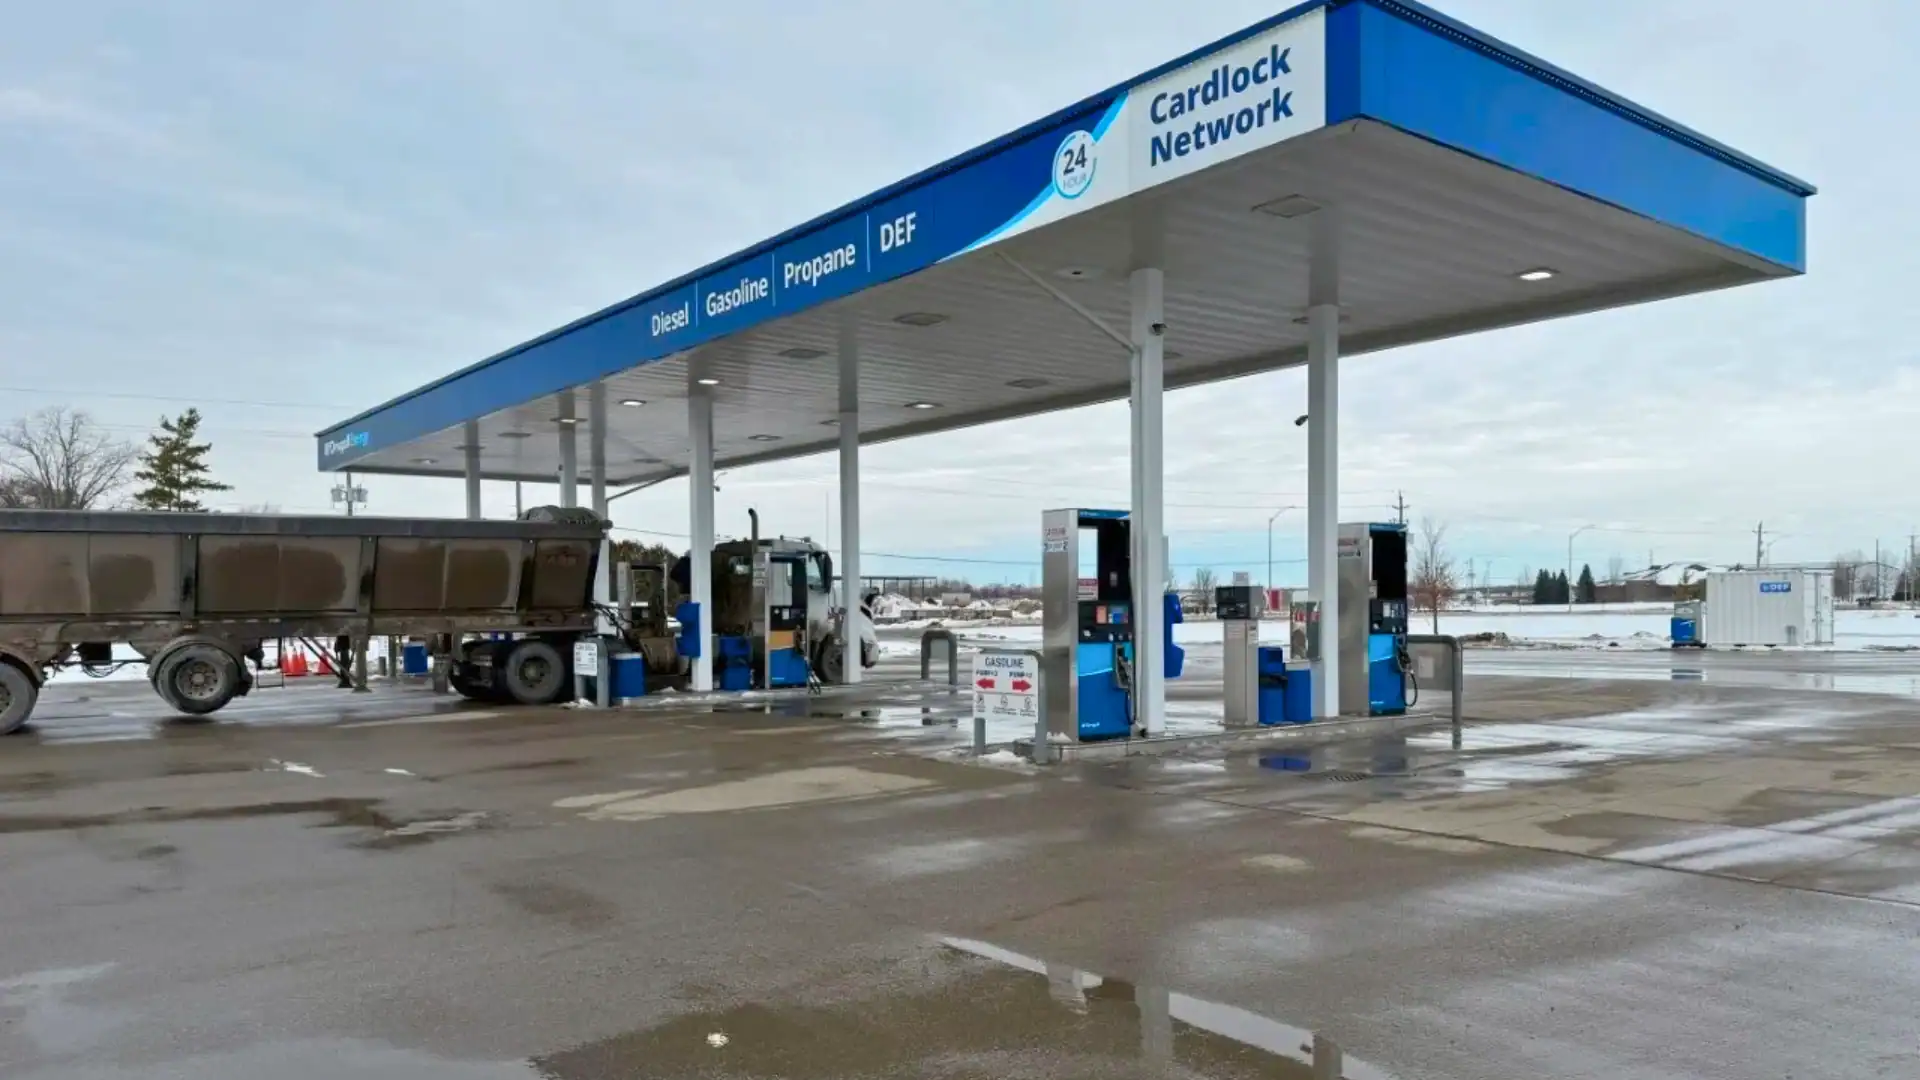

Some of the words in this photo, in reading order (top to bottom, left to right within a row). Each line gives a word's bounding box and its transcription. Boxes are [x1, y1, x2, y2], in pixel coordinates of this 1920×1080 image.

[1150, 45, 1291, 124] Cardlock
[1063, 143, 1087, 176] 24
[1150, 87, 1293, 167] Network
[652, 302, 689, 336] Diesel
[706, 277, 768, 317] Gasoline
[784, 243, 856, 288] Propane
[880, 212, 917, 252] DEF
